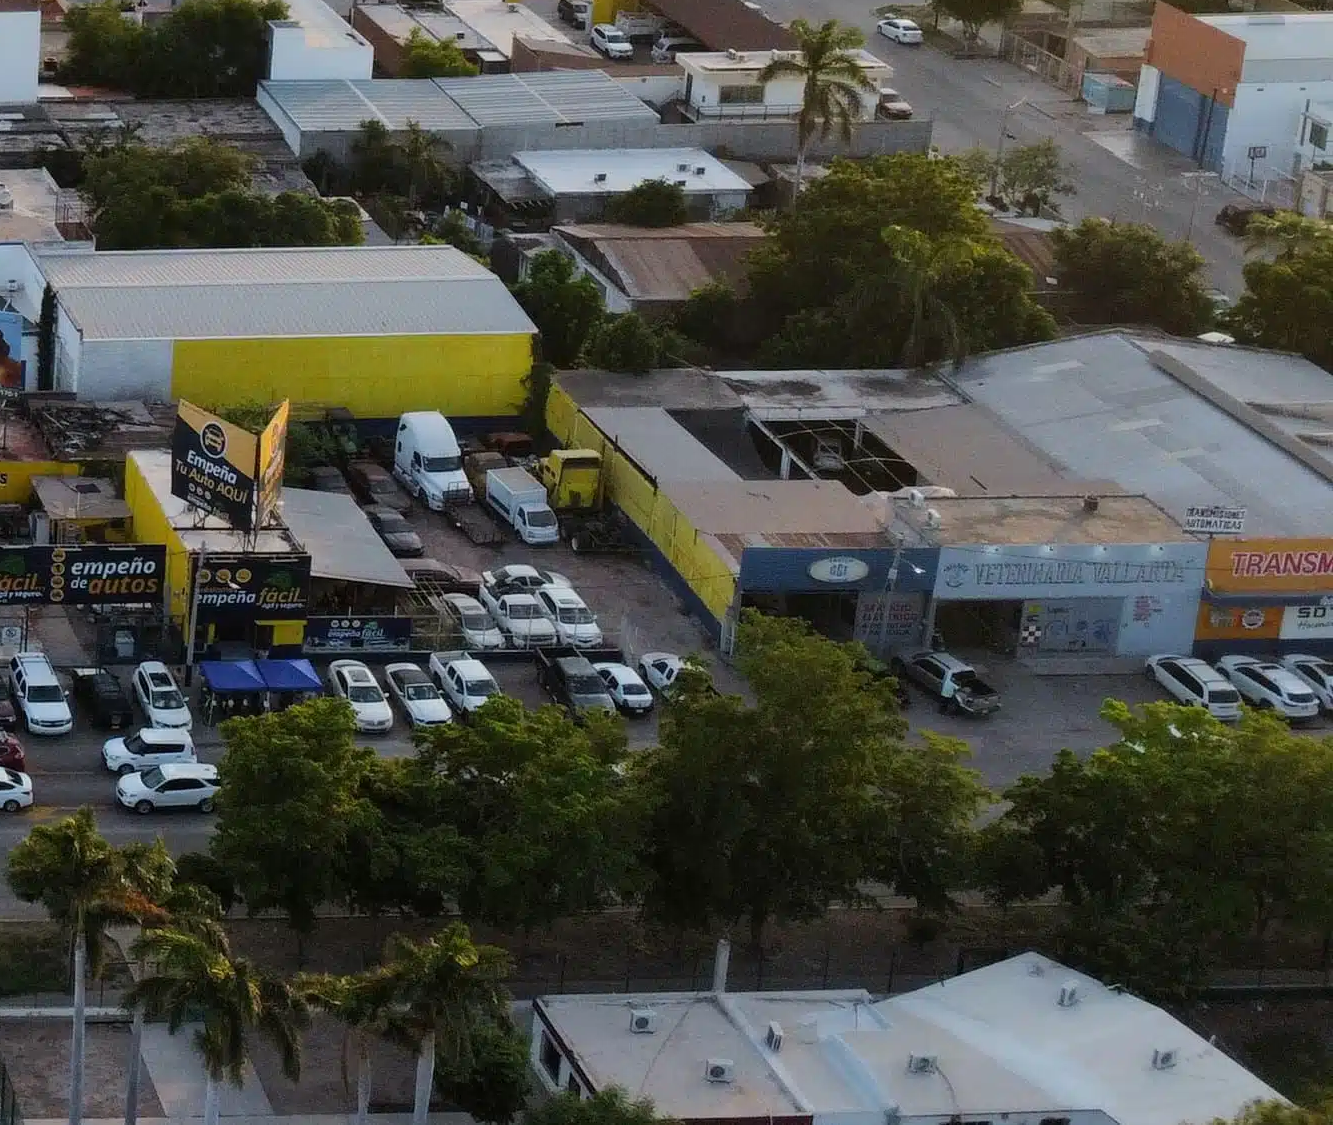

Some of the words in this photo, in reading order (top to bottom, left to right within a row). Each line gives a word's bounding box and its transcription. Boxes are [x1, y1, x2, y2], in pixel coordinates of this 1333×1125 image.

[174, 458, 187, 475] Tu
[188, 467, 215, 489] Auto
[186, 449, 237, 485] Empeña
[70, 556, 156, 580] empeño
[70, 576, 88, 589] de
[88, 576, 159, 595] autos
[196, 589, 256, 607] empeña
